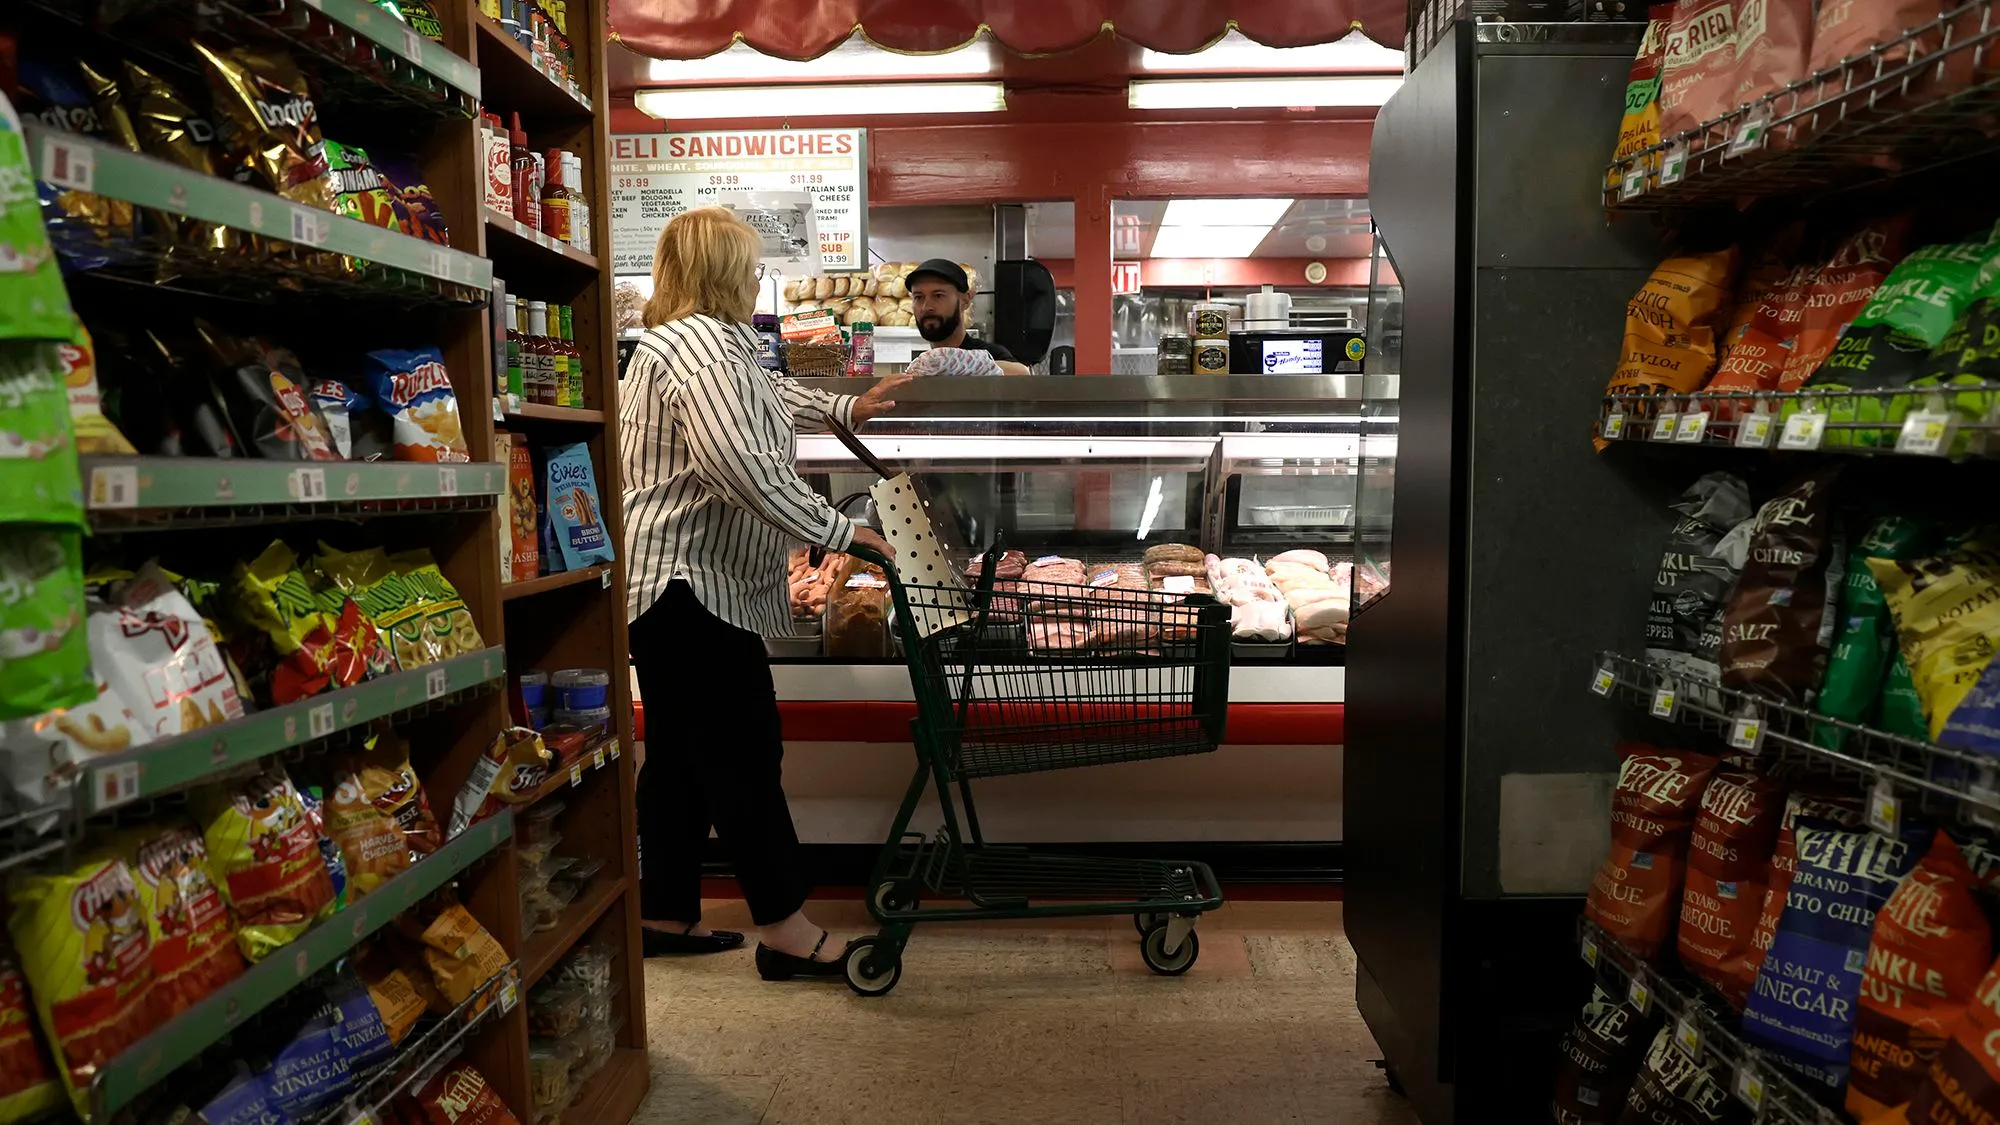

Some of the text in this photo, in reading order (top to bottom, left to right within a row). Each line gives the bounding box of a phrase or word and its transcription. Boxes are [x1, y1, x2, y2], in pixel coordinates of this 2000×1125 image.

[1688, 12, 1728, 49] RIED
[610, 134, 852, 159] ELI SANDWICHES
[619, 178, 649, 188] $8.99
[709, 175, 739, 185] $9.99
[790, 174, 823, 184] $11.99
[819, 194, 851, 202] CHEESE
[819, 232, 850, 241] RI TIP
[821, 243, 843, 253] SUB
[823, 255, 847, 263] 13.99
[550, 461, 588, 484] Evie's
[1753, 547, 1803, 565] CHIPS
[1656, 572, 1678, 587] UT
[1726, 621, 1778, 645] SALT
[1792, 870, 1850, 895] BRAND
[1782, 960, 1824, 986] SALT
[1826, 973, 1841, 991] &
[274, 1061, 300, 1081] SEA
[301, 1048, 331, 1070] SALT
[271, 1056, 352, 1099] VINEGAR
